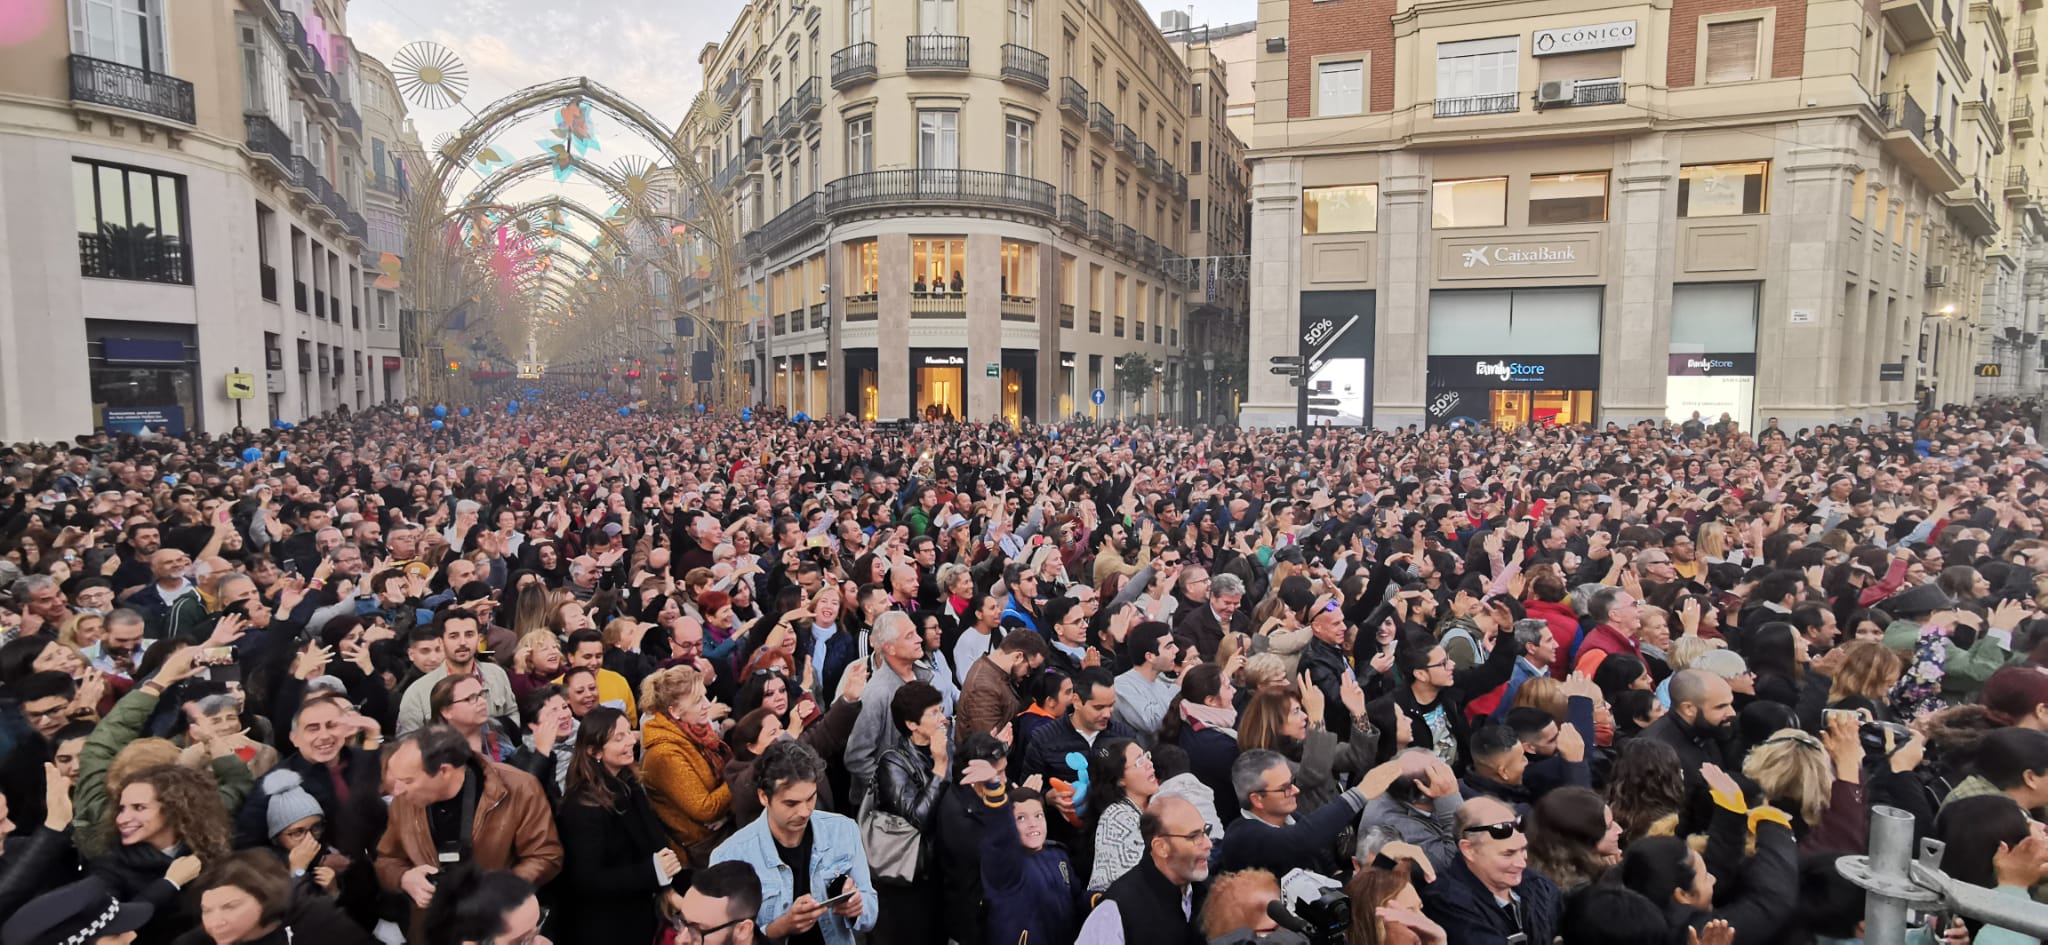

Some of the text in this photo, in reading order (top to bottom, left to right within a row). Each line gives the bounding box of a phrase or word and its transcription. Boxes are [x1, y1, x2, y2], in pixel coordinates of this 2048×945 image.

[1561, 26, 1633, 43] CÓNICO
[1494, 245, 1575, 261] CaixaBank
[1303, 318, 1332, 345] 50%
[1428, 390, 1459, 415] 50%
